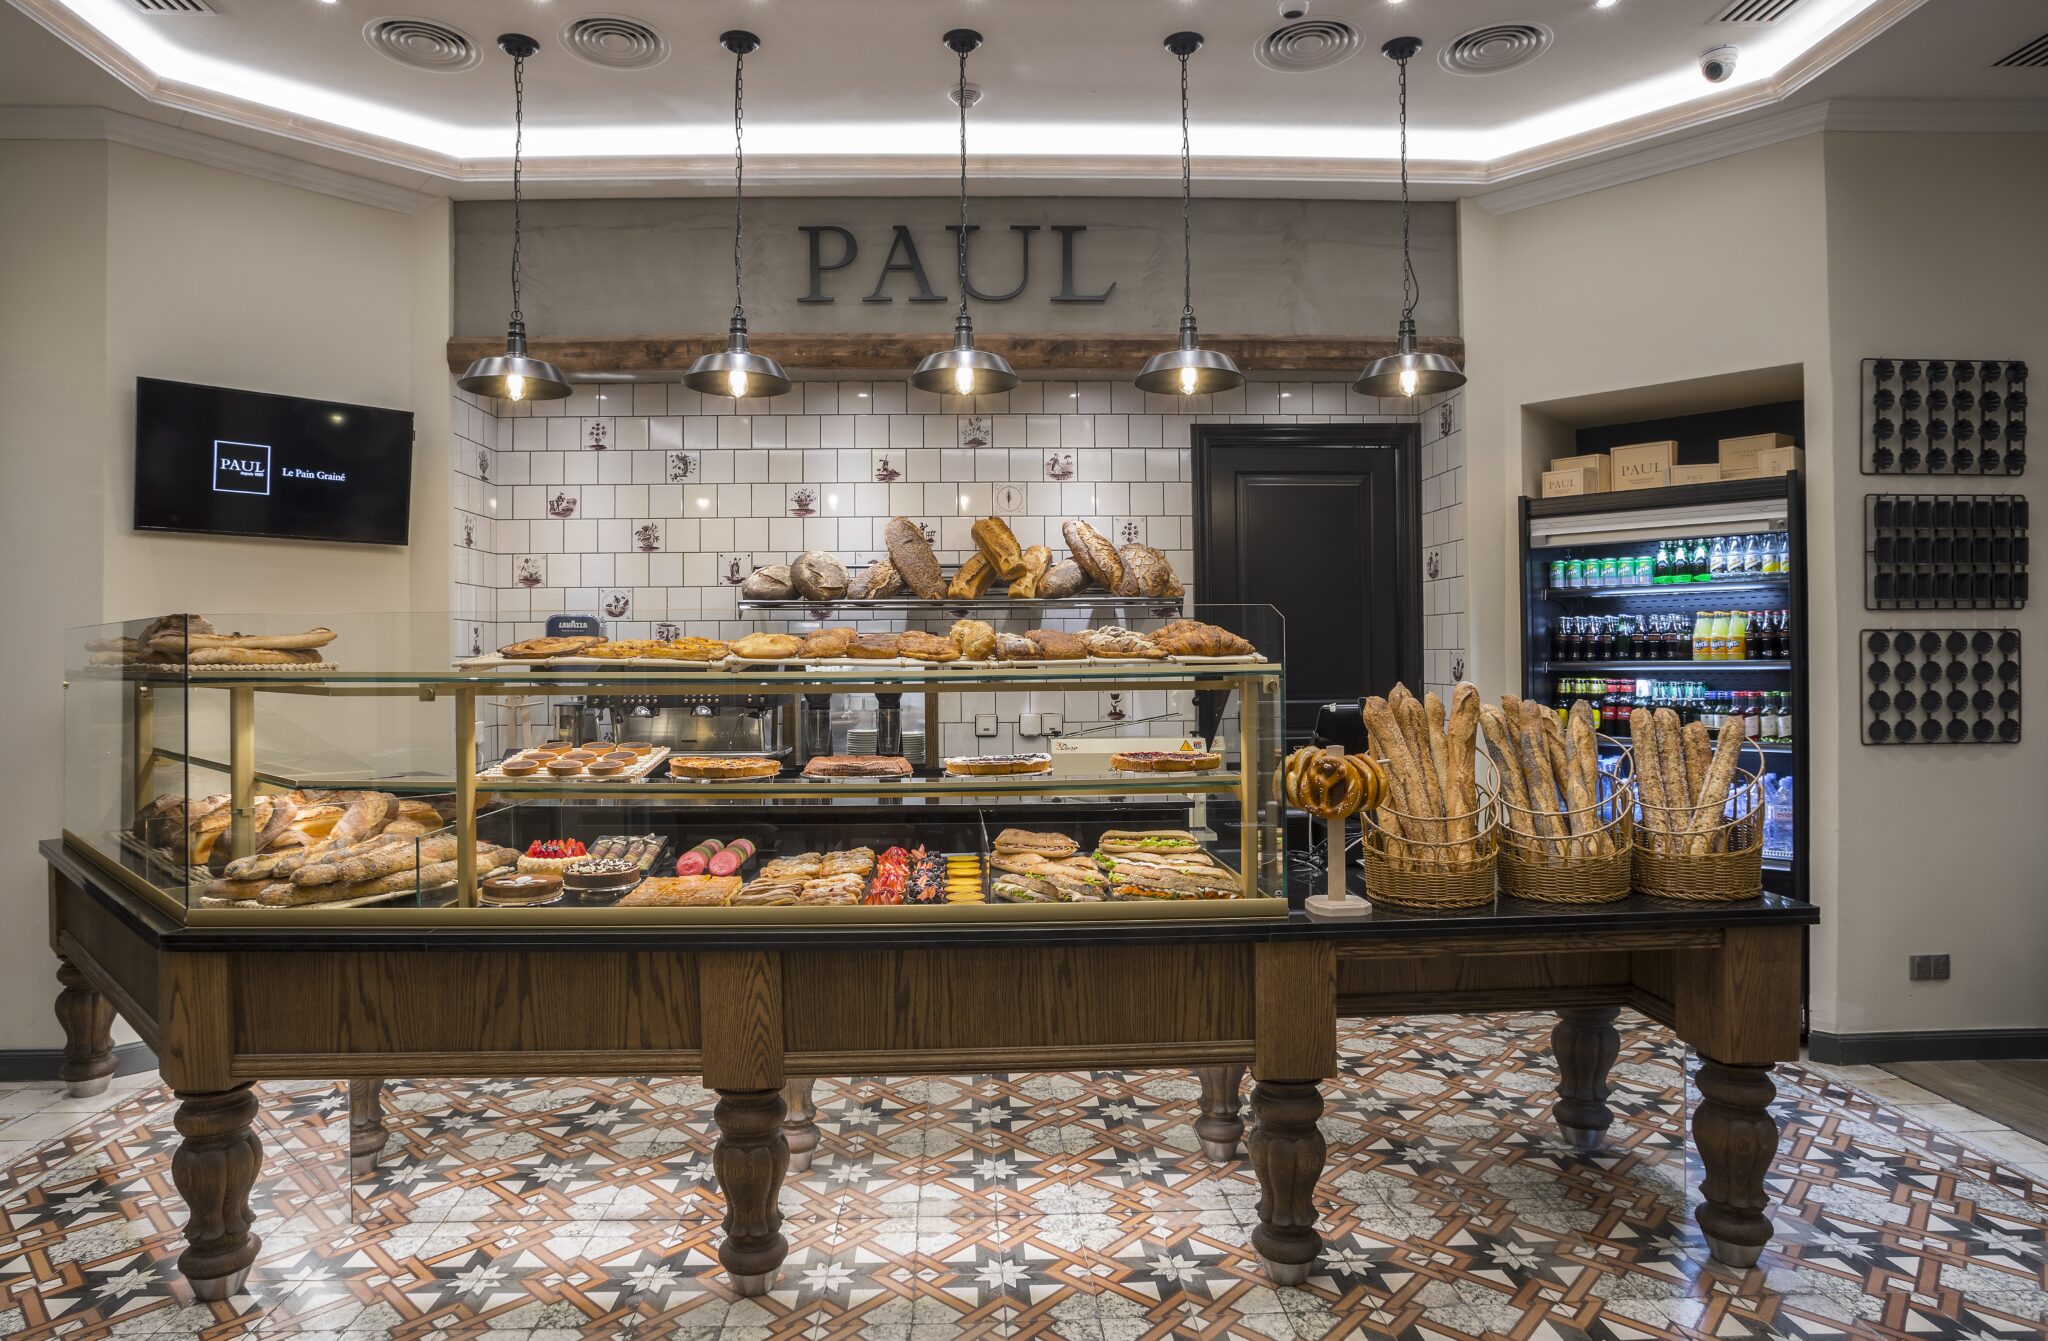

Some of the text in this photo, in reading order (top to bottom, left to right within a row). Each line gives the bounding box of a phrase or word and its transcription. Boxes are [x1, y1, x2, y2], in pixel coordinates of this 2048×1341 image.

[797, 225, 1116, 302] PAUL
[220, 458, 265, 472] PAUL
[1620, 462, 1663, 476] PAUL
[282, 468, 346, 481] Le Pain Grainé
[1548, 479, 1576, 490] PAUL
